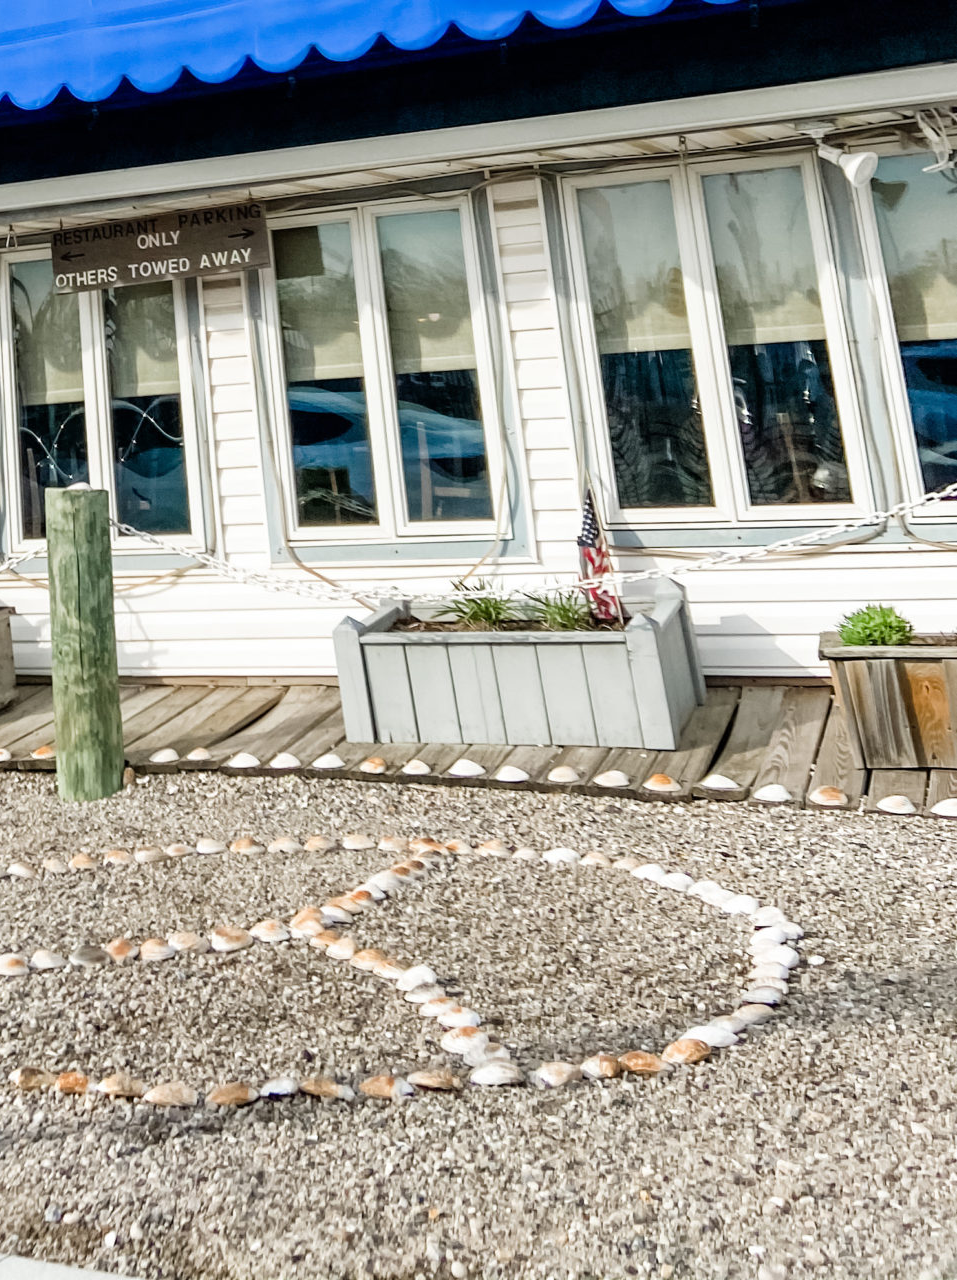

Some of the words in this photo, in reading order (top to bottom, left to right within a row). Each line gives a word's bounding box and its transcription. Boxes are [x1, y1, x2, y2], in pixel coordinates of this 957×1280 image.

[53, 218, 159, 247] RESTAURANT
[178, 203, 262, 228] PARKING
[136, 230, 181, 250] ONLY
[55, 266, 119, 288] OTHERS
[128, 257, 191, 279] TOWED
[199, 247, 252, 269] AWAY
